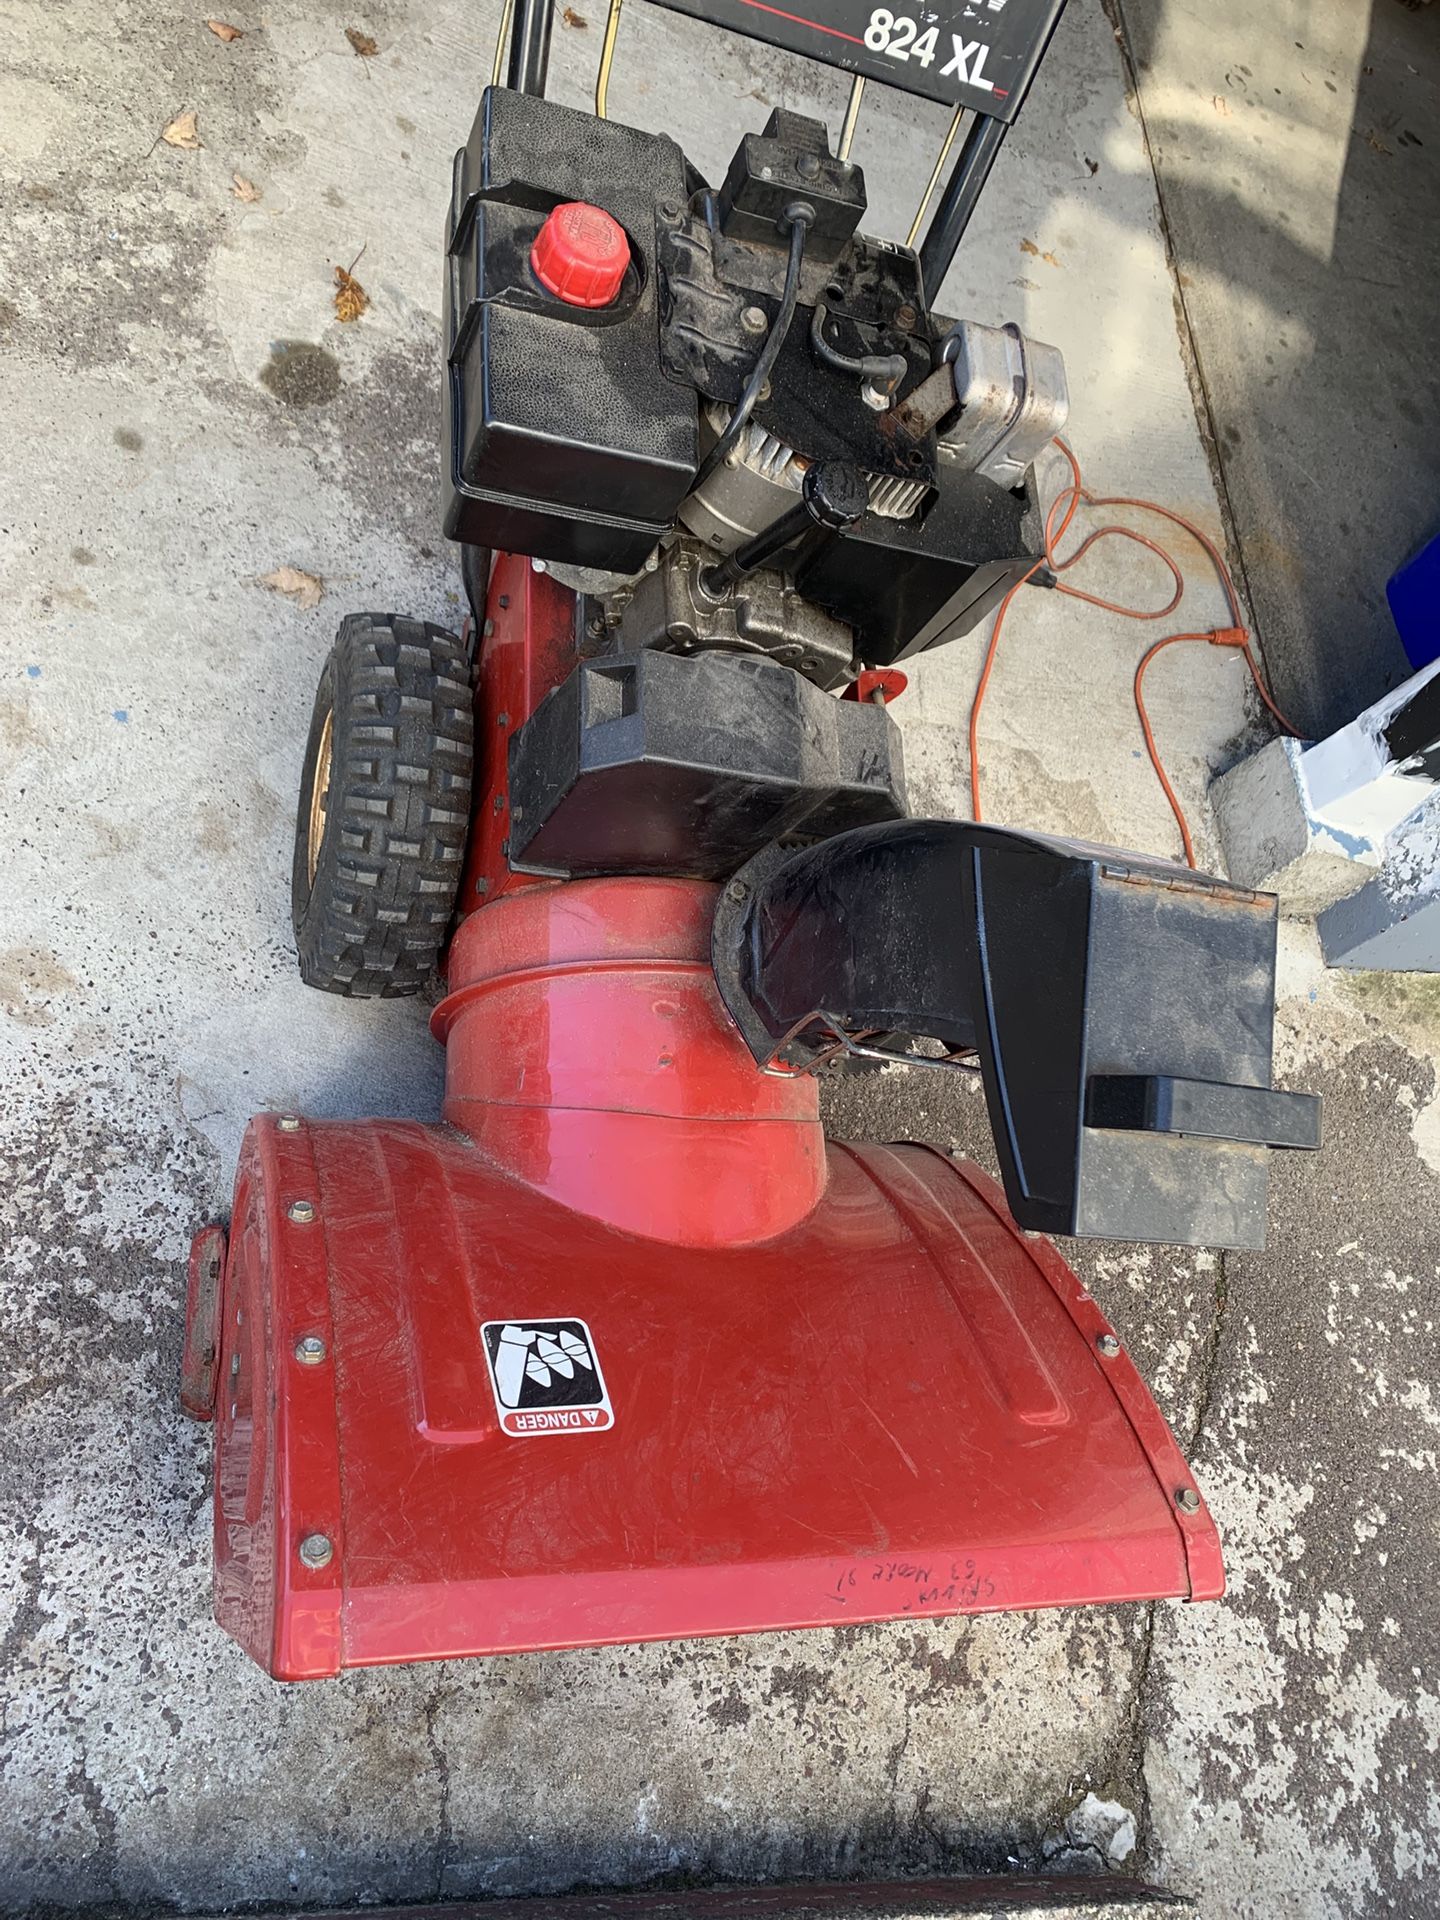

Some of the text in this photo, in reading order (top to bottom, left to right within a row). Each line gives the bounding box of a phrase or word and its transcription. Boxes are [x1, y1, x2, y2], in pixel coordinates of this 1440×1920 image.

[864, 8, 995, 91] 824 XL
[514, 1411, 582, 1430] DANGER
